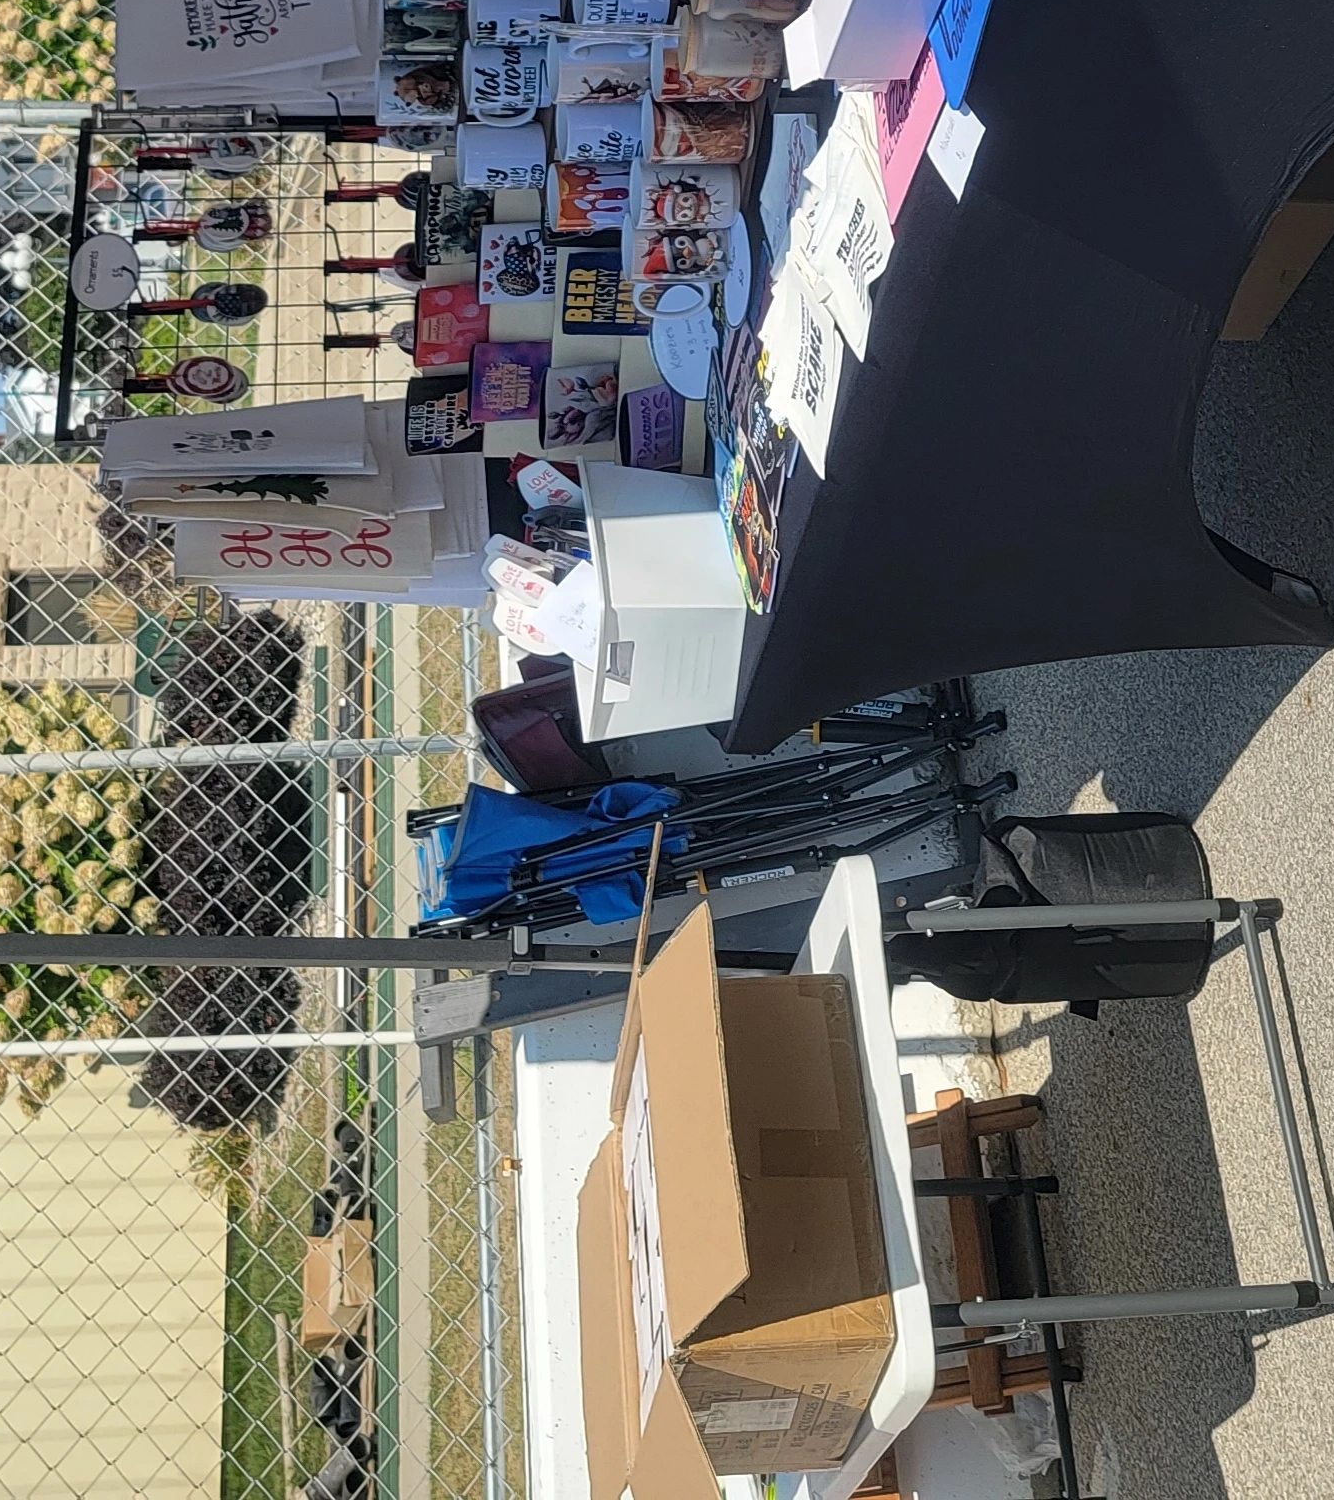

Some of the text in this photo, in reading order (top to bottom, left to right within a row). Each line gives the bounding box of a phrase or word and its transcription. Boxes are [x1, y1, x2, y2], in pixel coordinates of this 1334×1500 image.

[201, 4, 217, 32] MADE
[609, 0, 619, 25] WILL
[475, 20, 498, 46] NE
[474, 67, 501, 103] Not
[426, 184, 442, 266] CAMPING
[84, 250, 99, 294] Ornaments
[111, 267, 124, 278] $5
[542, 258, 557, 295] GAME
[565, 268, 598, 323] BEER
[593, 268, 618, 323] MAKES MY
[805, 316, 823, 417] SCARE
[502, 363, 517, 410] DRINK
[408, 404, 426, 441] LIFE IS
[424, 400, 436, 443] BETTER
[435, 409, 447, 435] BY THE
[444, 394, 457, 447] CAMPFIRE
[636, 396, 653, 466] Because
[652, 390, 671, 460] KIDS
[525, 468, 555, 490] LOVE
[499, 564, 517, 583] LOVE
[729, 868, 786, 887] ROCKER
[810, 1383, 827, 1395] CM
